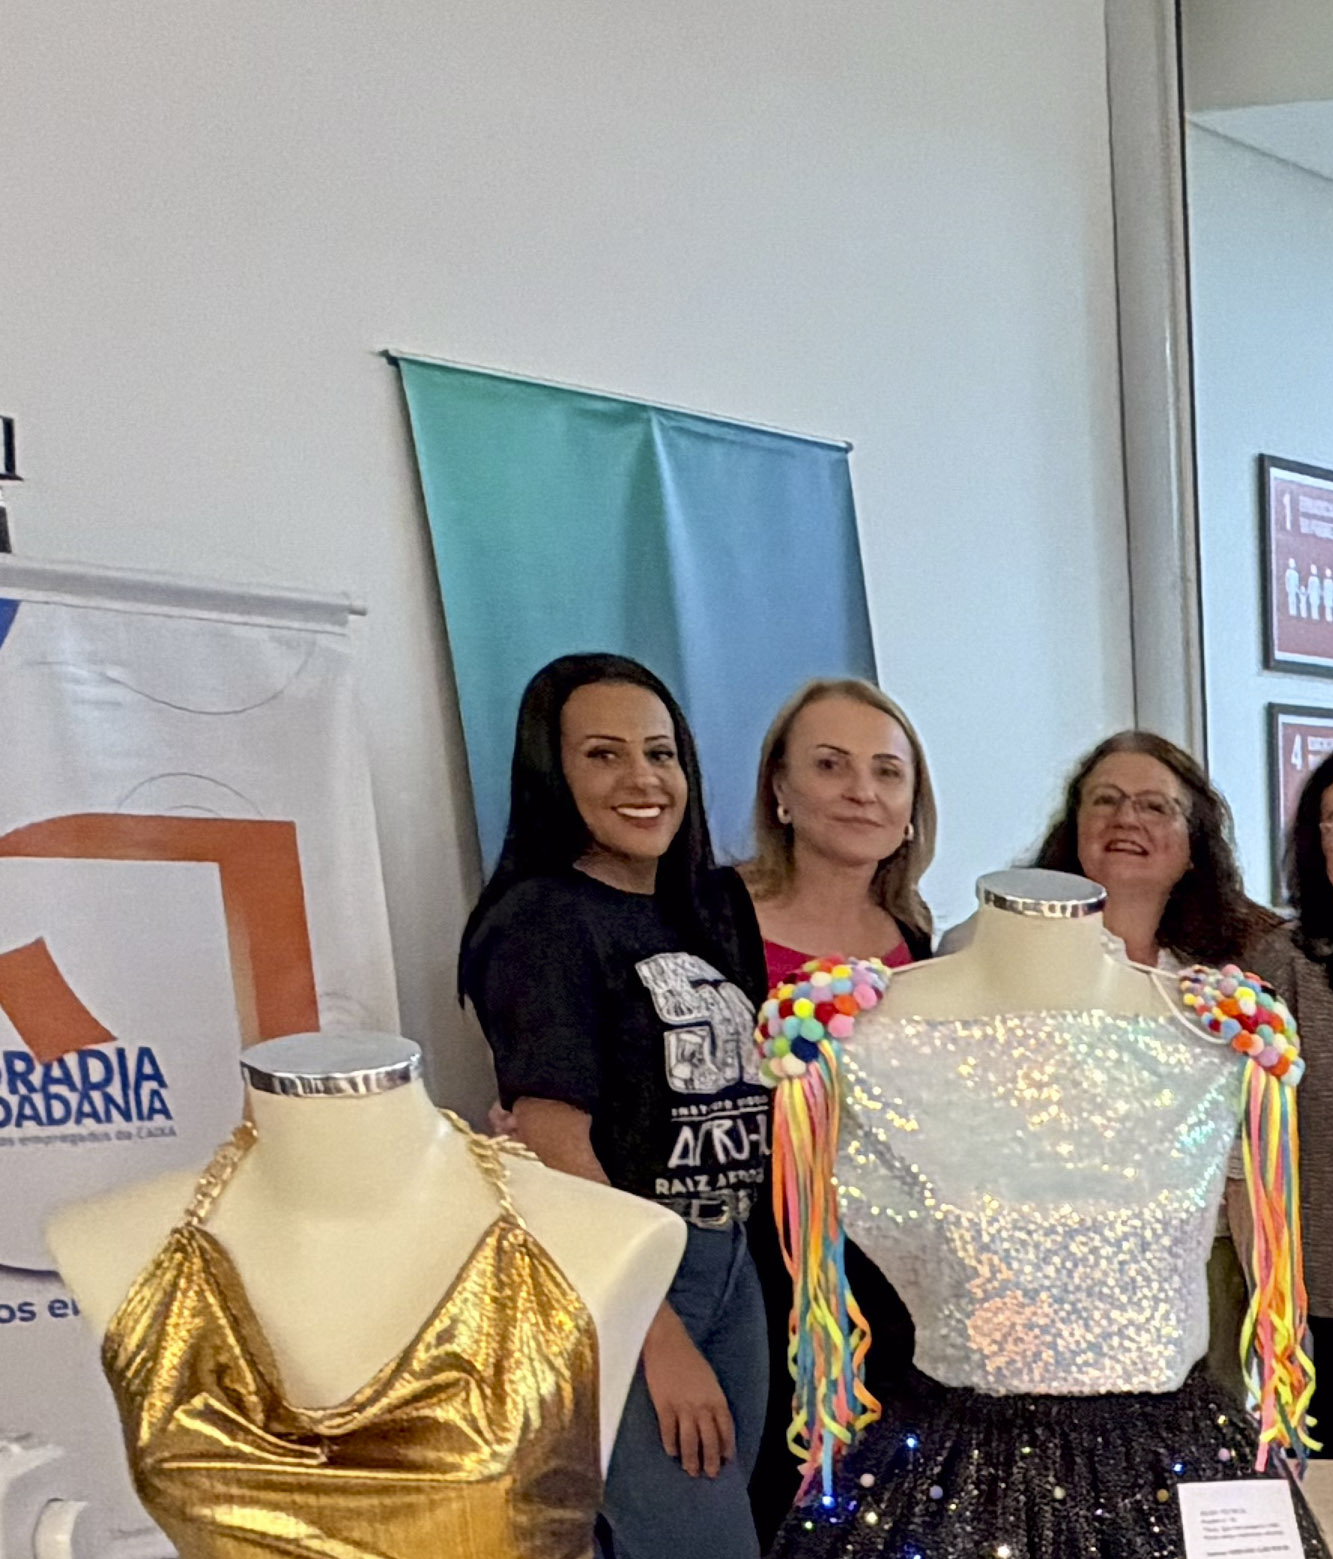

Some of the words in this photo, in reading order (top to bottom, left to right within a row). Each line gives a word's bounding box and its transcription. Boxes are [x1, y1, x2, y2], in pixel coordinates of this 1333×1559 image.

[1282, 493, 1292, 531] 1
[1290, 733, 1303, 771] 4
[0, 1046, 168, 1096] RADIA
[655, 1174, 711, 1195] RAIZ
